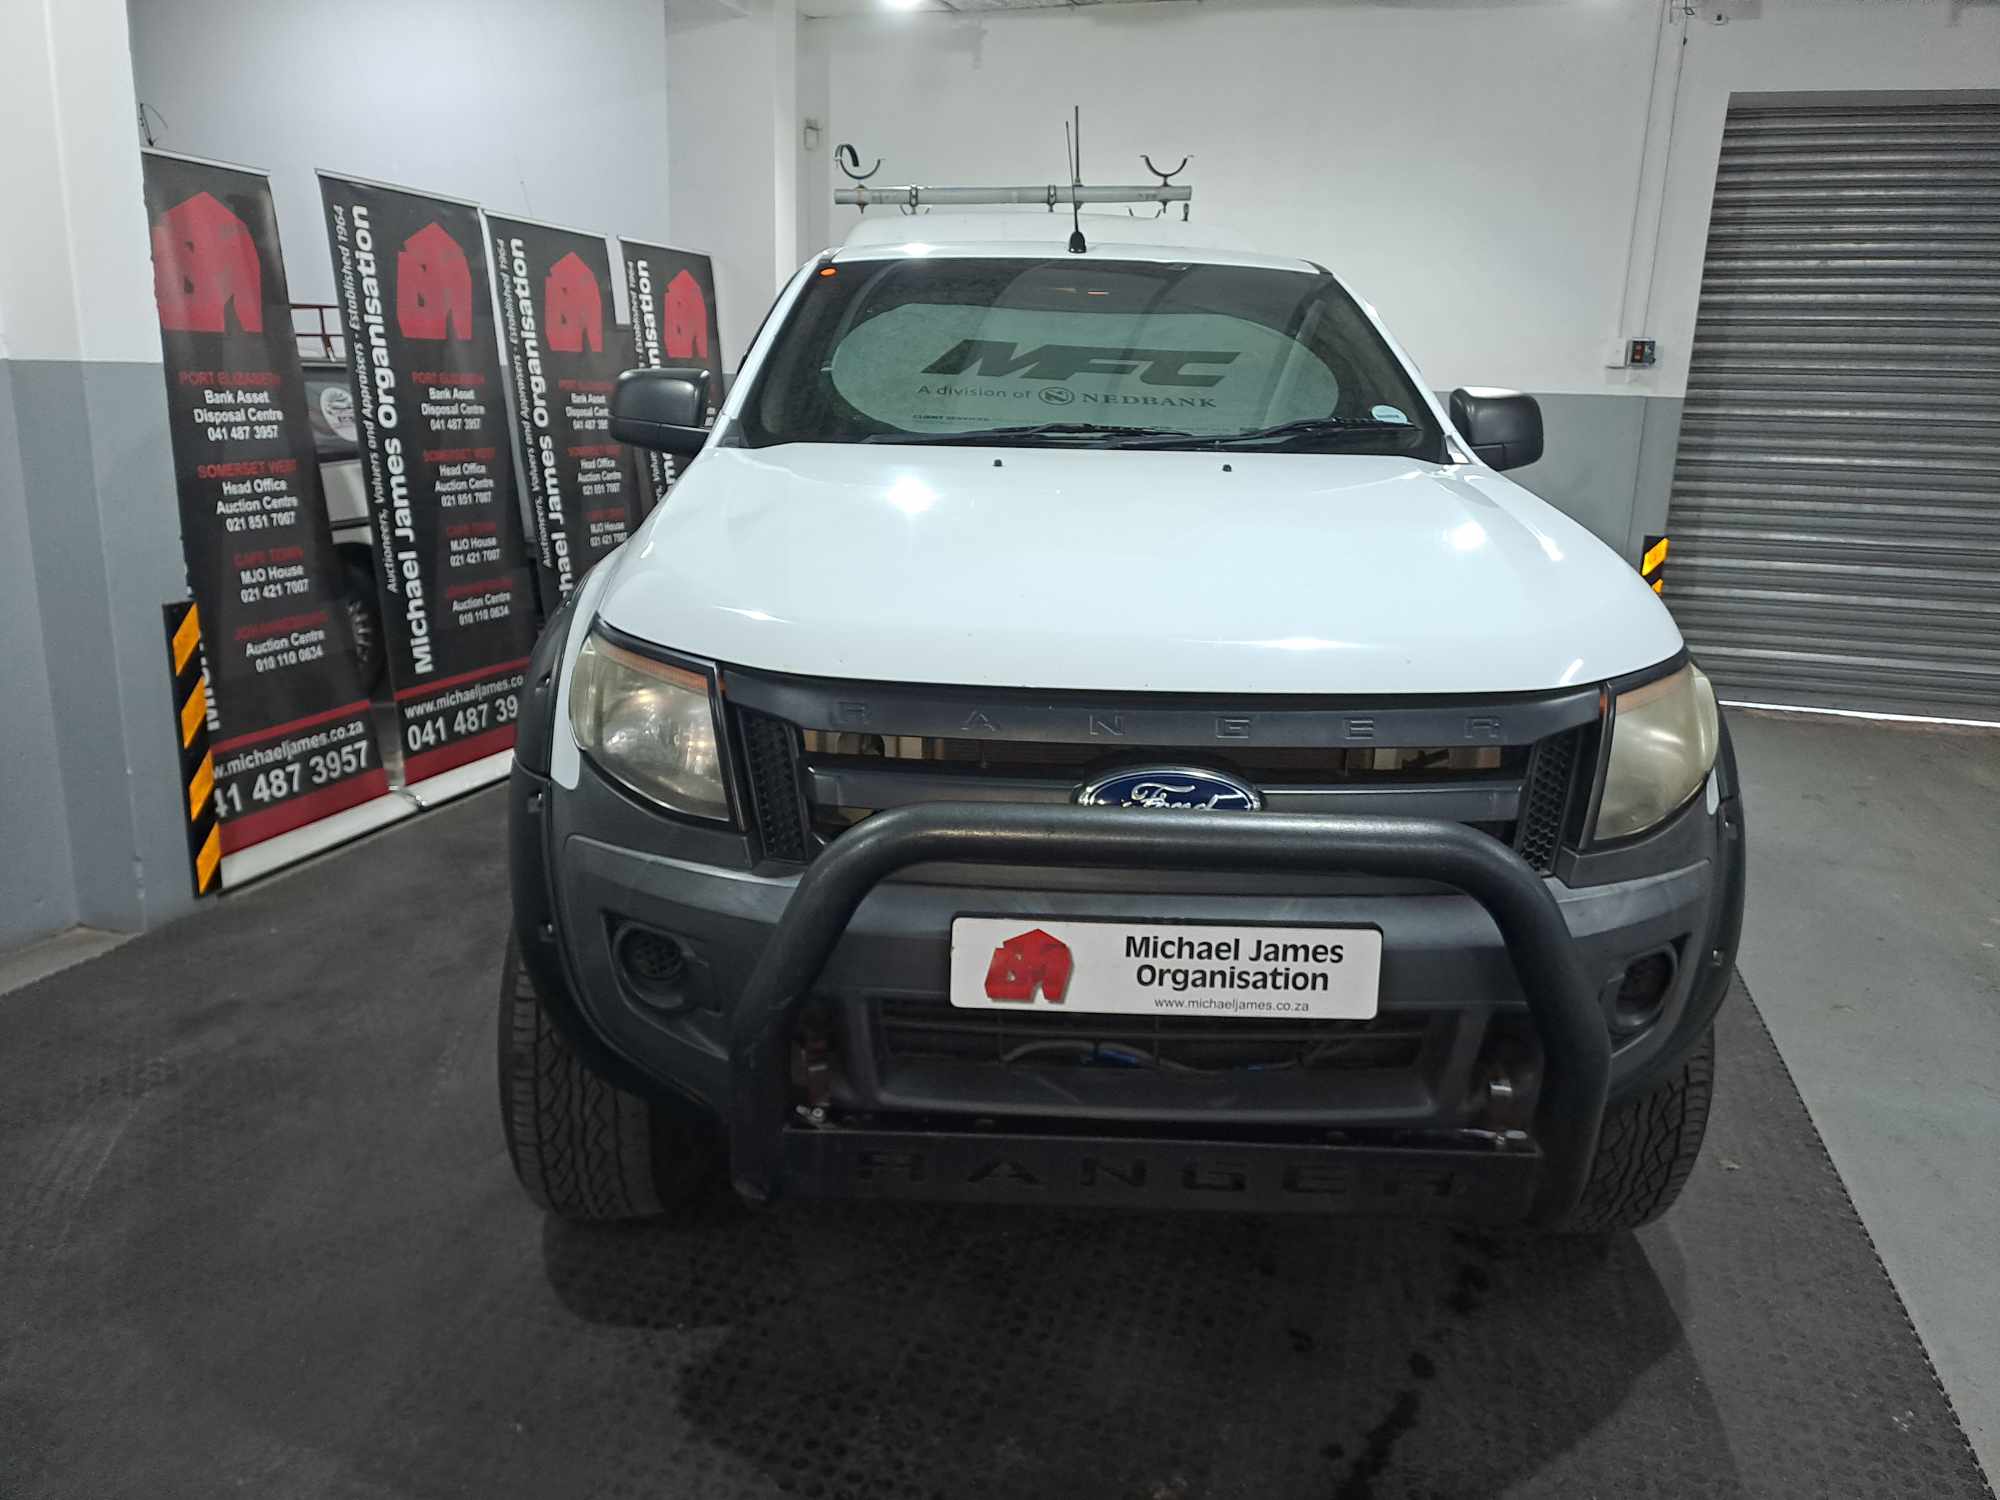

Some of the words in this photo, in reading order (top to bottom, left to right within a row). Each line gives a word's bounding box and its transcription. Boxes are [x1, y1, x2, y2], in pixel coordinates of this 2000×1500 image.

[333, 204, 349, 243] 1964
[338, 244, 361, 331] Established
[352, 204, 398, 429] Organisation
[510, 238, 549, 428] Organisation
[920, 339, 1241, 388] MFC
[354, 342, 376, 418] Appraisers
[429, 387, 451, 400] Bank
[452, 387, 475, 400] Asset
[204, 389, 235, 404] Bank
[237, 390, 270, 404] Asset
[917, 384, 931, 395] A
[936, 384, 1007, 398] division
[1012, 387, 1030, 400] of
[1082, 392, 1218, 408] NEDBANK
[193, 408, 246, 425] Disposal
[248, 407, 284, 422] Centre
[421, 403, 459, 417] Disposal
[460, 403, 485, 415] Centre
[207, 427, 229, 441] 041
[231, 426, 250, 440] 487
[254, 425, 278, 439] 3957
[363, 419, 378, 450] and
[520, 420, 533, 445] and
[369, 450, 385, 504] Valuers
[439, 465, 461, 477] Head
[462, 463, 486, 475] Office
[527, 447, 541, 492] Valuers
[539, 435, 564, 525] James
[222, 481, 251, 495] Head
[254, 477, 288, 493] Office
[385, 437, 415, 543] James
[435, 480, 467, 492] Auction
[469, 478, 494, 490] Centre
[216, 498, 262, 515] Auction
[263, 495, 299, 510] Centre
[226, 517, 247, 532] 021
[248, 514, 268, 530] 851
[379, 508, 398, 593] Auctioneers,
[470, 537, 497, 549] House
[240, 568, 266, 584] MJO
[268, 565, 304, 580] House
[551, 532, 574, 598] hael
[240, 588, 261, 604] 021
[262, 583, 283, 598] 421
[284, 578, 309, 595] 7007
[452, 597, 483, 612] Auction
[485, 592, 511, 606] Centre
[398, 550, 434, 675] Michael
[246, 636, 289, 657] Auction
[290, 629, 326, 647] Centre
[255, 656, 276, 672] 010
[277, 651, 297, 667] 110
[407, 716, 447, 751] 041
[453, 703, 489, 735] 487
[495, 694, 518, 722] 39
[252, 762, 301, 802] 487
[309, 740, 369, 784] 3957
[1125, 935, 1240, 961] Michael
[1250, 938, 1344, 963] James
[1136, 964, 1329, 991] Organisation
[1154, 997, 1310, 1012] www.michaeljames.co.za
